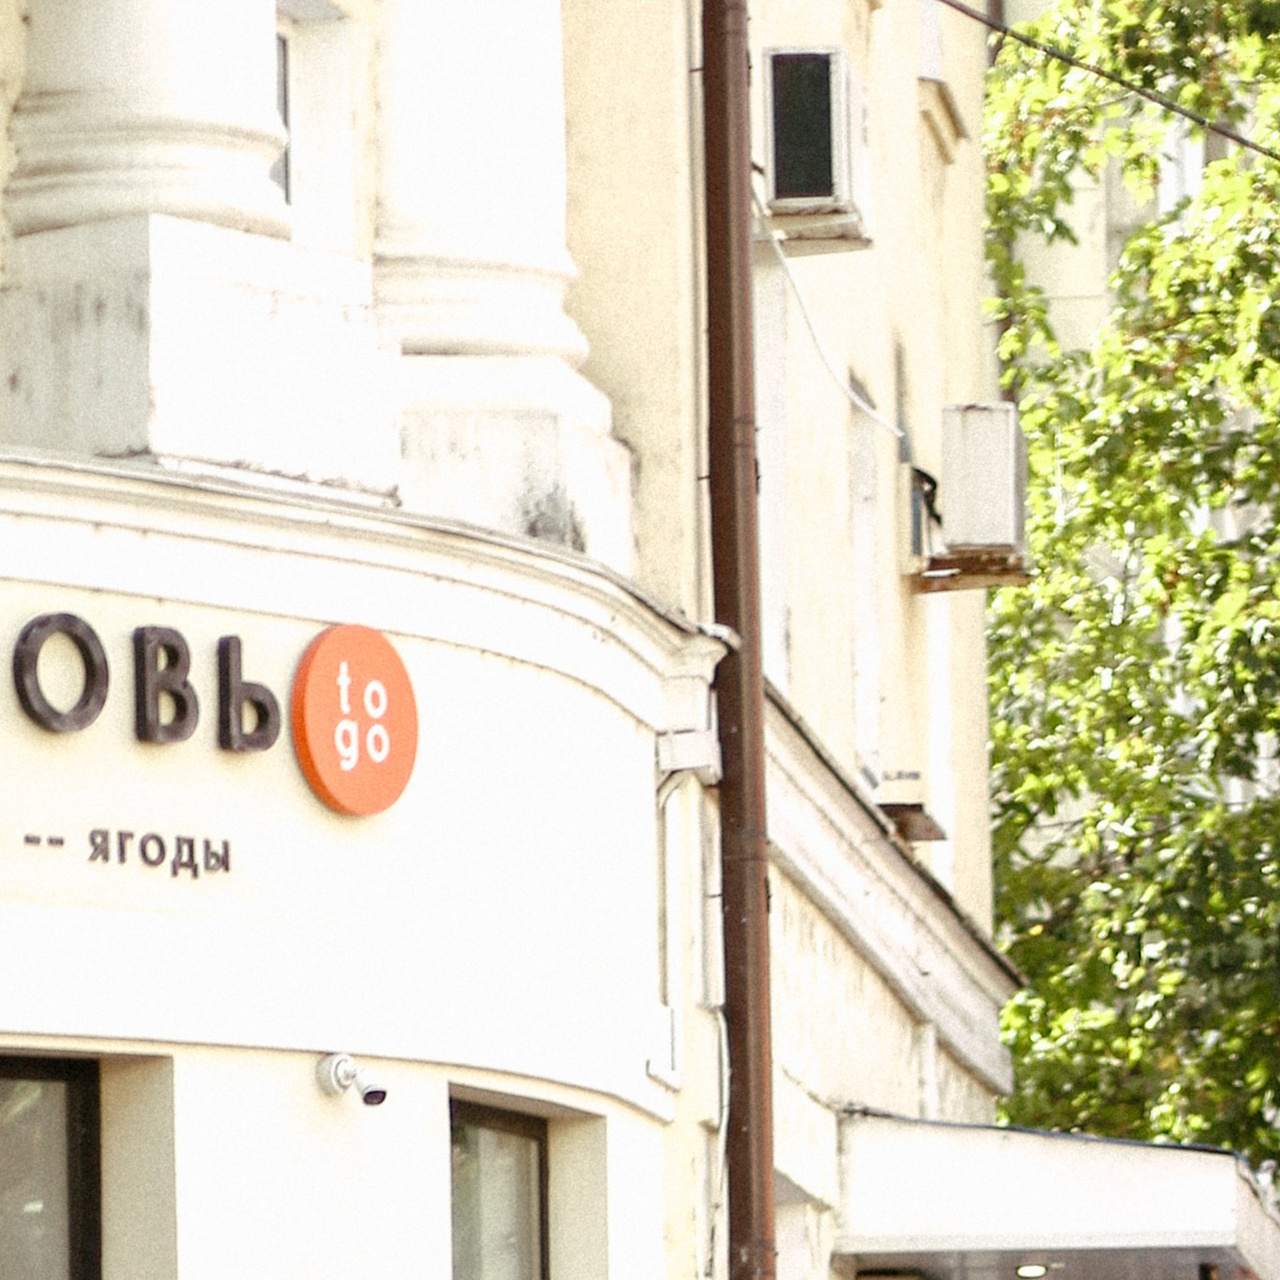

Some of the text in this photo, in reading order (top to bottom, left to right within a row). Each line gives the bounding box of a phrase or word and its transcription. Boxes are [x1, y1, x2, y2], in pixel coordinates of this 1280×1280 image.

[337, 661, 388, 719] to
[335, 719, 390, 771] go
[88, 829, 231, 878] ягоды
